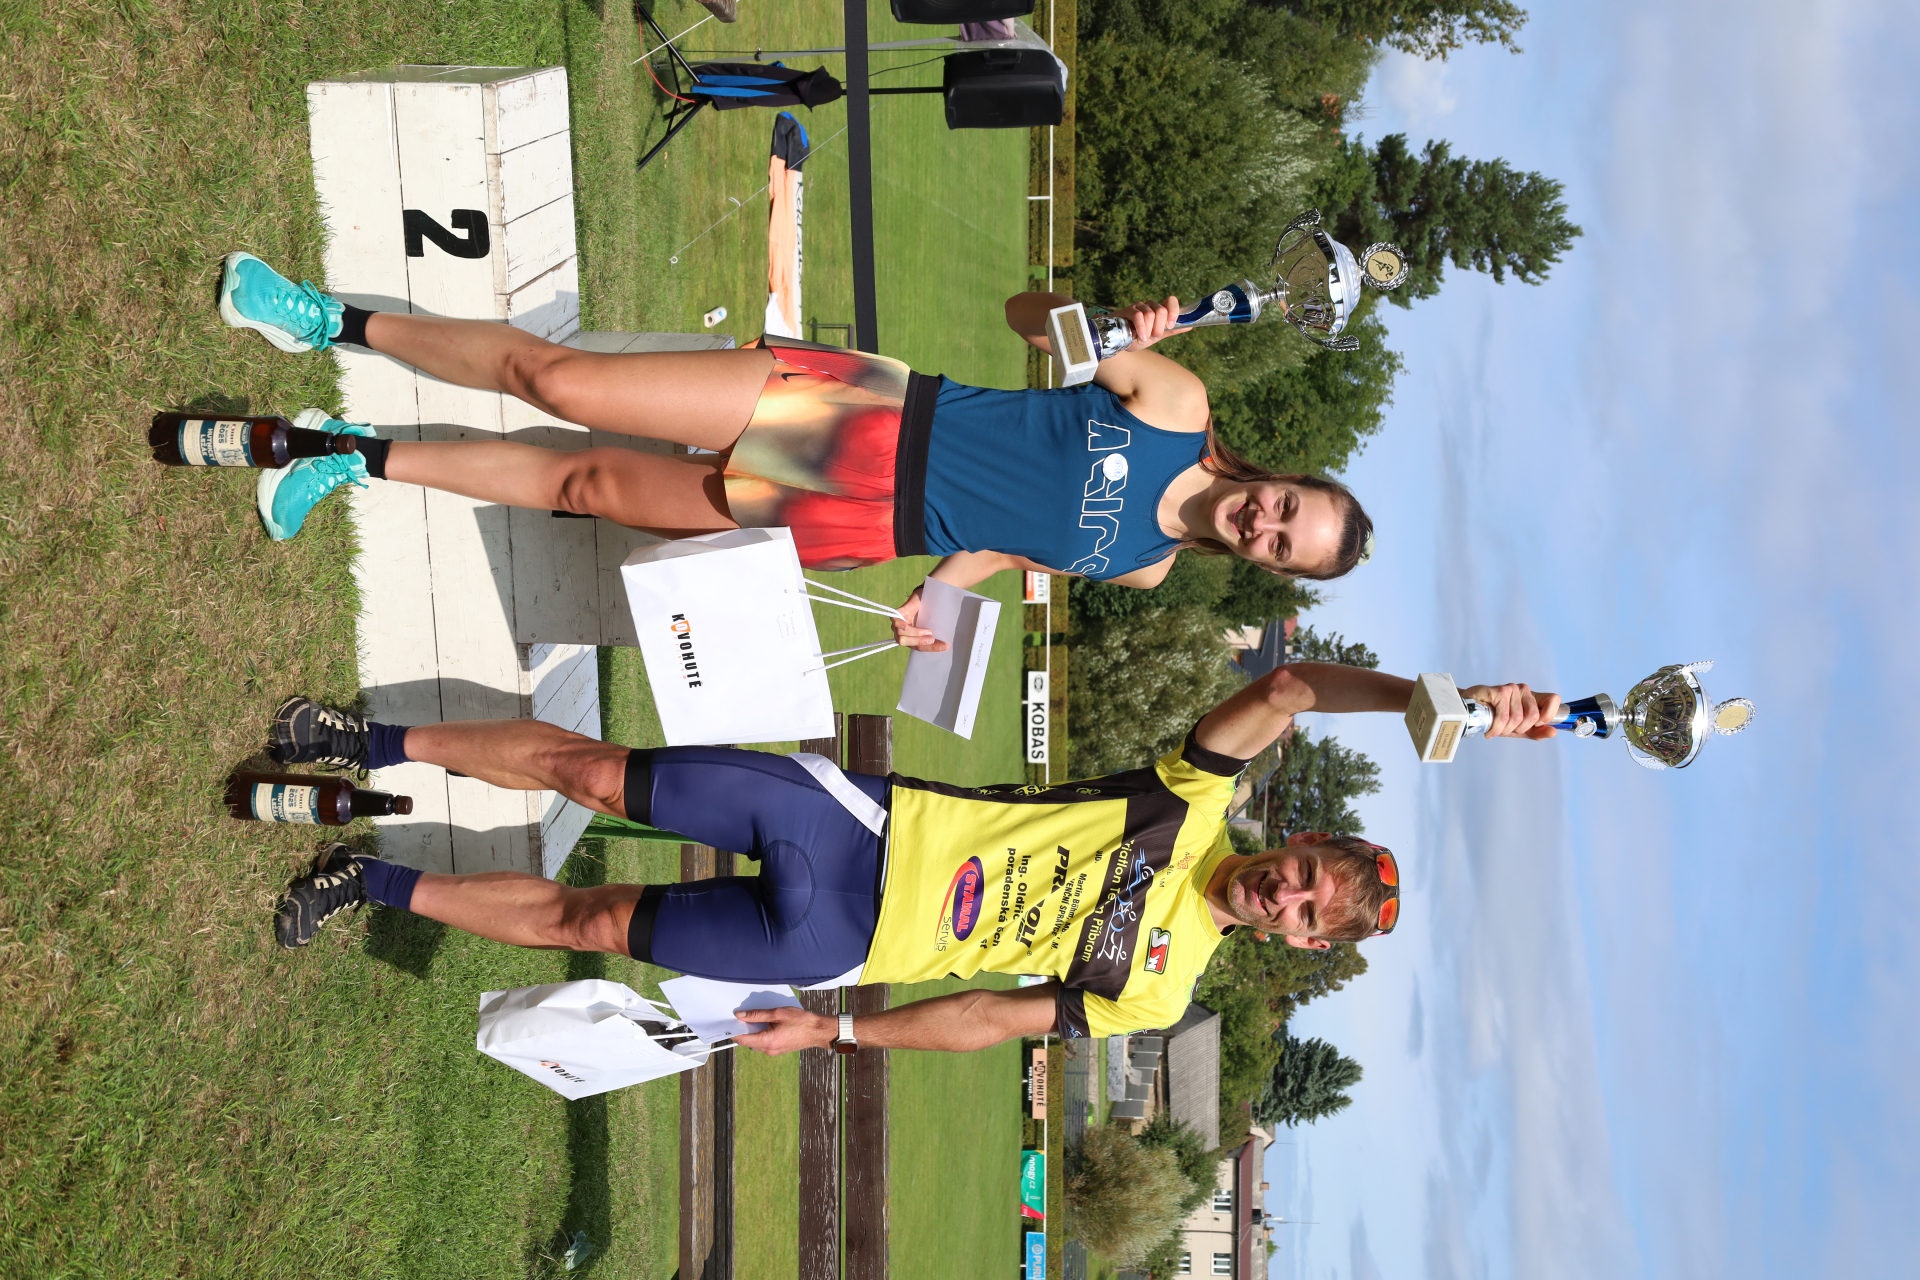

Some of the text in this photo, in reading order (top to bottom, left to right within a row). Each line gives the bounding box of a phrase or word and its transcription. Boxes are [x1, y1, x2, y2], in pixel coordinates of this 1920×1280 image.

[403, 209, 490, 259] 2
[200, 434, 208, 456] LEŽÁK
[218, 424, 226, 444] 2025
[670, 614, 703, 688] KOVOHUTĚ
[1031, 702, 1045, 760] KOBAS
[998, 848, 1016, 923] poradenská
[1018, 855, 1032, 878] Ing.
[1074, 873, 1087, 897] Martin
[956, 874, 976, 932] STAMAL
[1012, 882, 1027, 921] Oldřic
[1060, 878, 1075, 904] VENČNÍ
[1094, 887, 1120, 914] Tem
[1081, 918, 1105, 963] Příbram
[1034, 1060, 1047, 1107] KOVOHUTĚ
[1027, 1154, 1037, 1189] innogy.cz
